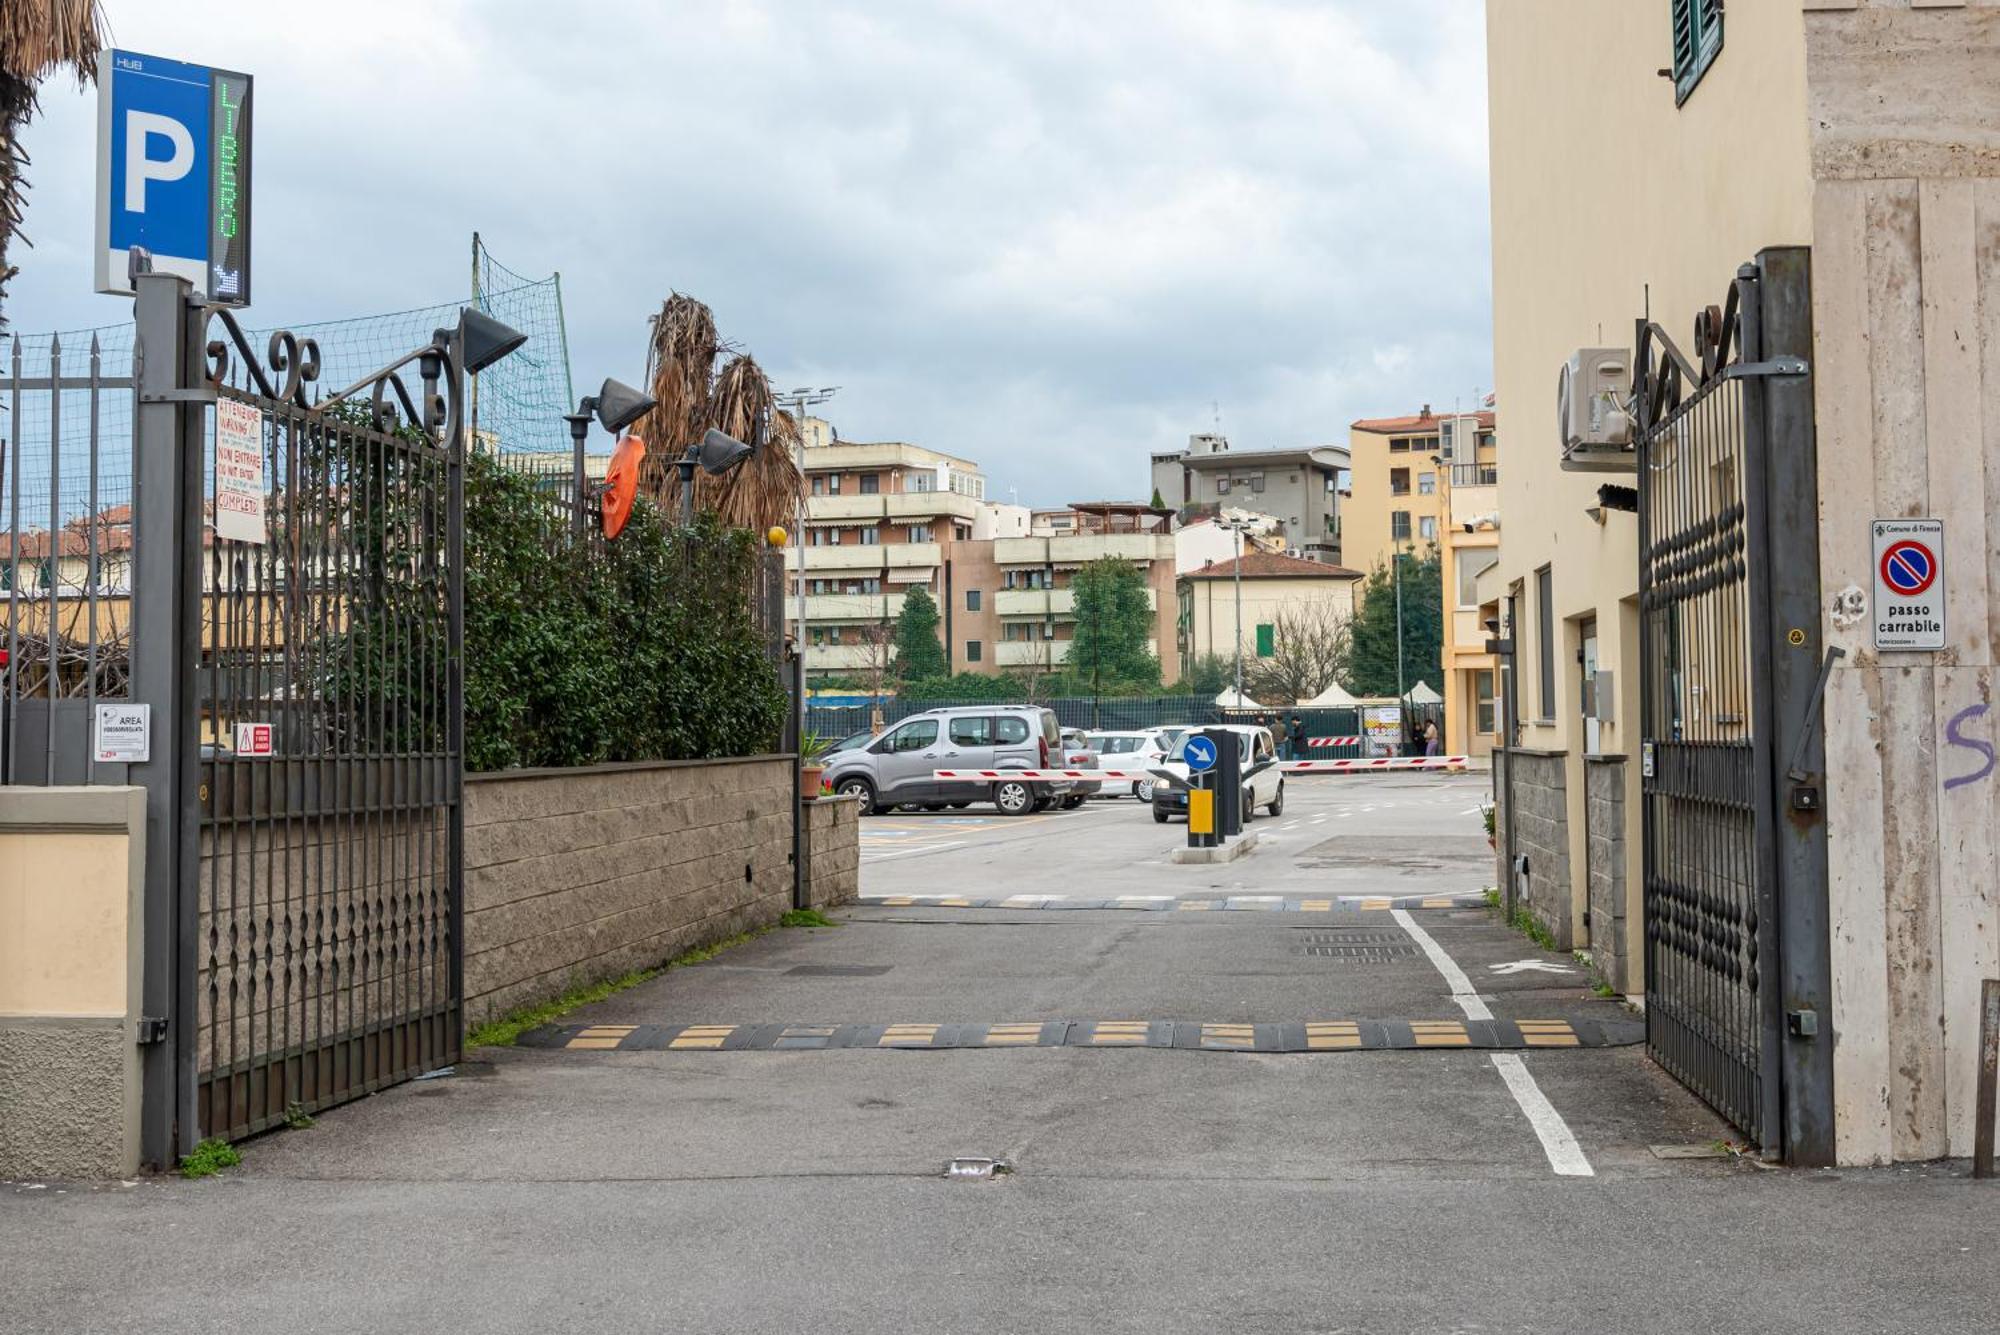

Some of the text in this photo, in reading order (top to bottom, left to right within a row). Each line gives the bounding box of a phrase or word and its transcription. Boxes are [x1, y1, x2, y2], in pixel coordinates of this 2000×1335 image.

[117, 57, 142, 70] HUB
[125, 109, 195, 213] P
[219, 83, 237, 238] LIBERO
[218, 446, 260, 469] NON ENTRARE
[218, 463, 226, 475] DO
[228, 465, 238, 476] NOT
[218, 493, 257, 512] COMPLETO
[1886, 523, 1940, 532] Comune di Firenze
[1888, 606, 1930, 618] passo
[1879, 619, 1941, 632] carrabile
[119, 717, 142, 725] AREA
